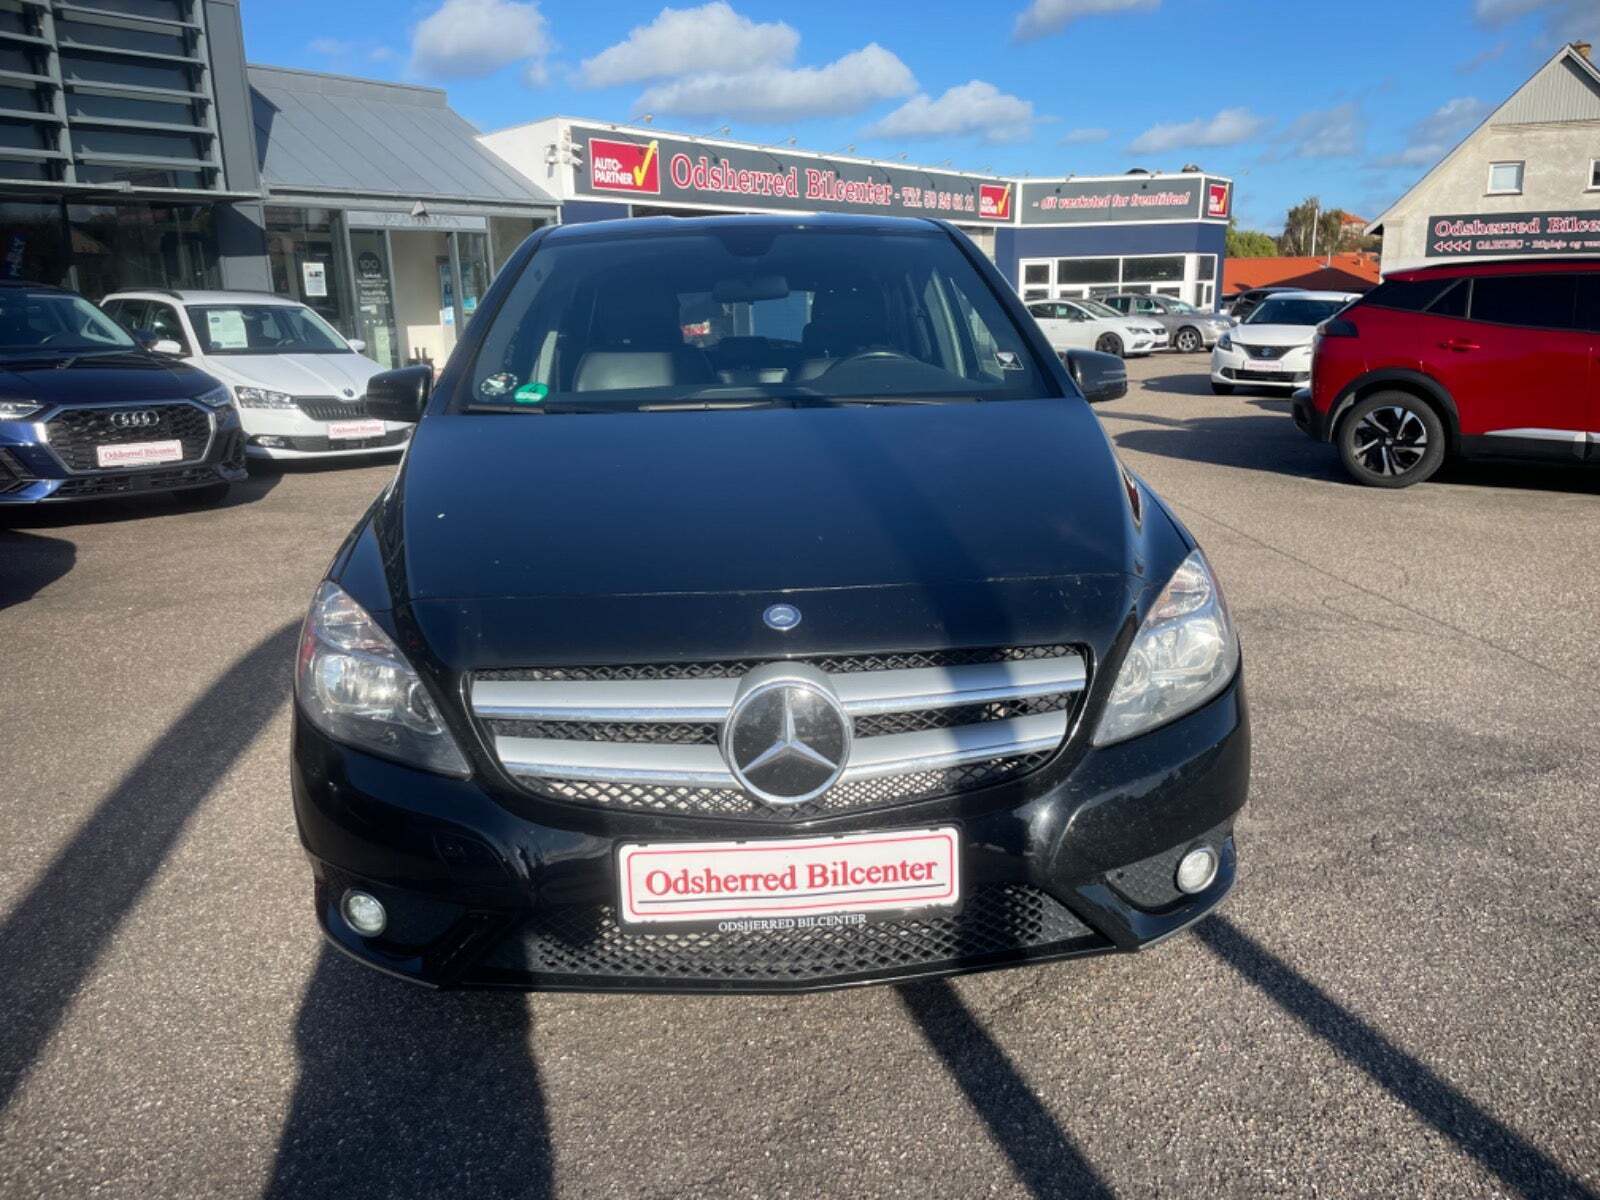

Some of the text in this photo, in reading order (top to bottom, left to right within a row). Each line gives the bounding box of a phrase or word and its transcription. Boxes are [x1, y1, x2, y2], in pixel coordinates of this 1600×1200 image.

[670, 153, 799, 198] Odsherred
[805, 167, 892, 206] Bilcenter
[1434, 217, 1540, 238] Odsherred
[645, 859, 938, 896] Odsherred Bilcenter
[718, 914, 867, 933] ODSHERRED BILCENTER
